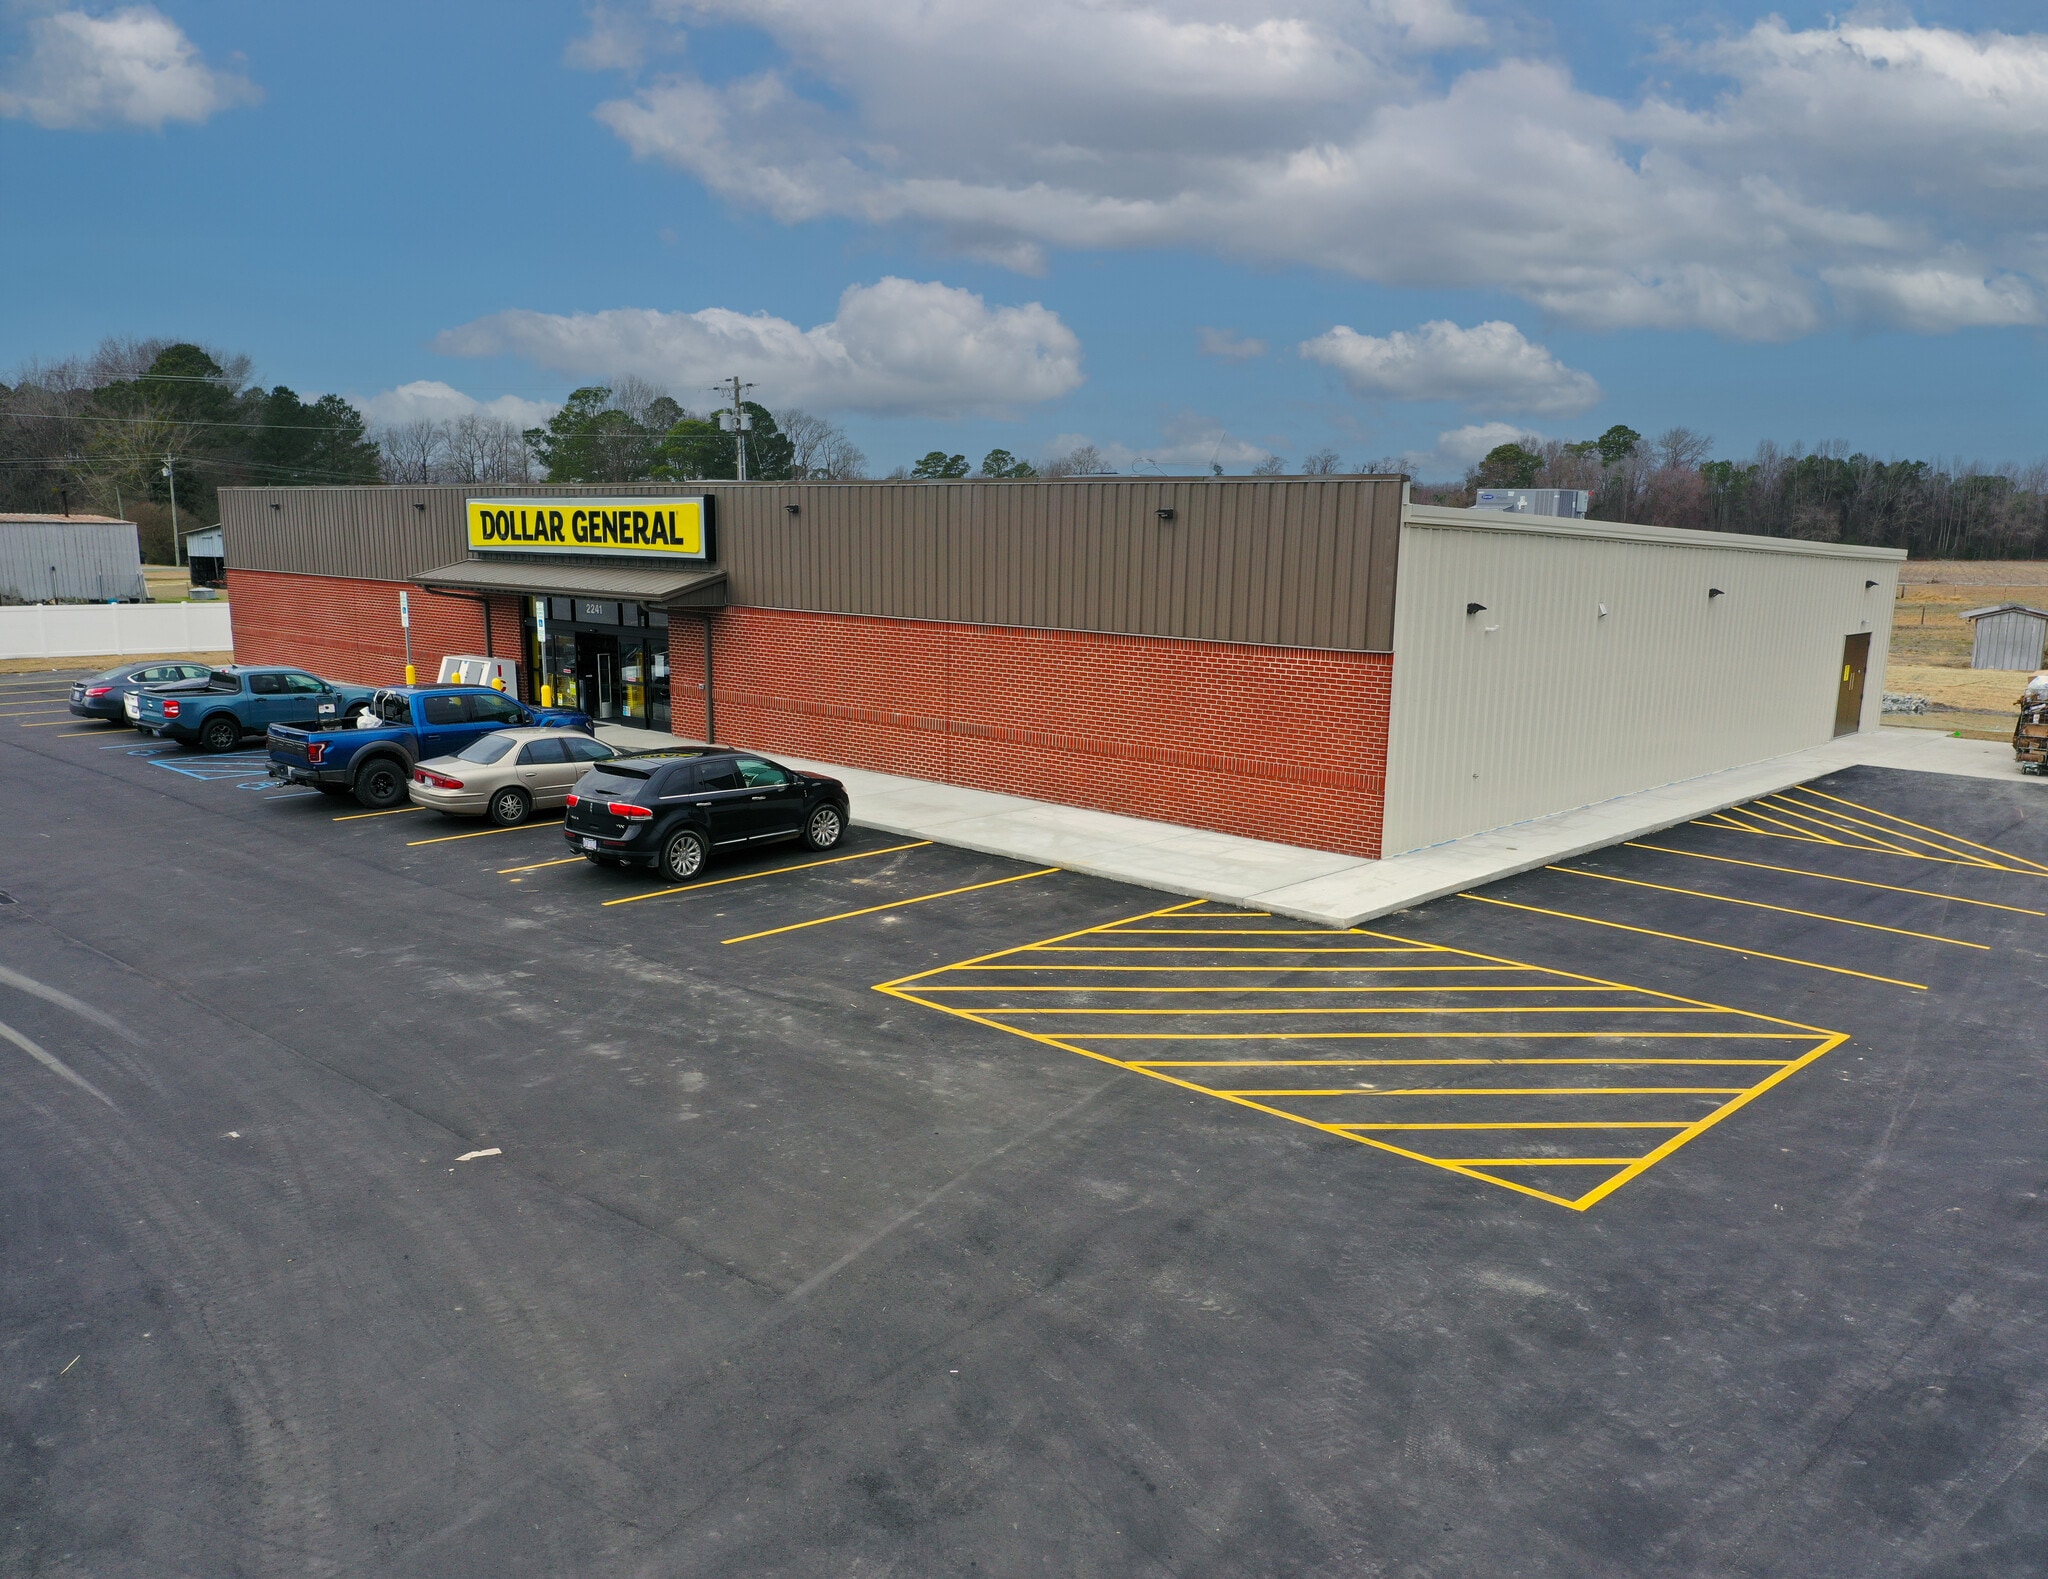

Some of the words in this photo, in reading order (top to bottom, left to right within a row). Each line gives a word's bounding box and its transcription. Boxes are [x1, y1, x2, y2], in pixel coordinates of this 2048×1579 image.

[480, 510, 565, 542] DOLLAR
[572, 510, 684, 545] GENERAL
[586, 603, 603, 615] 2241
